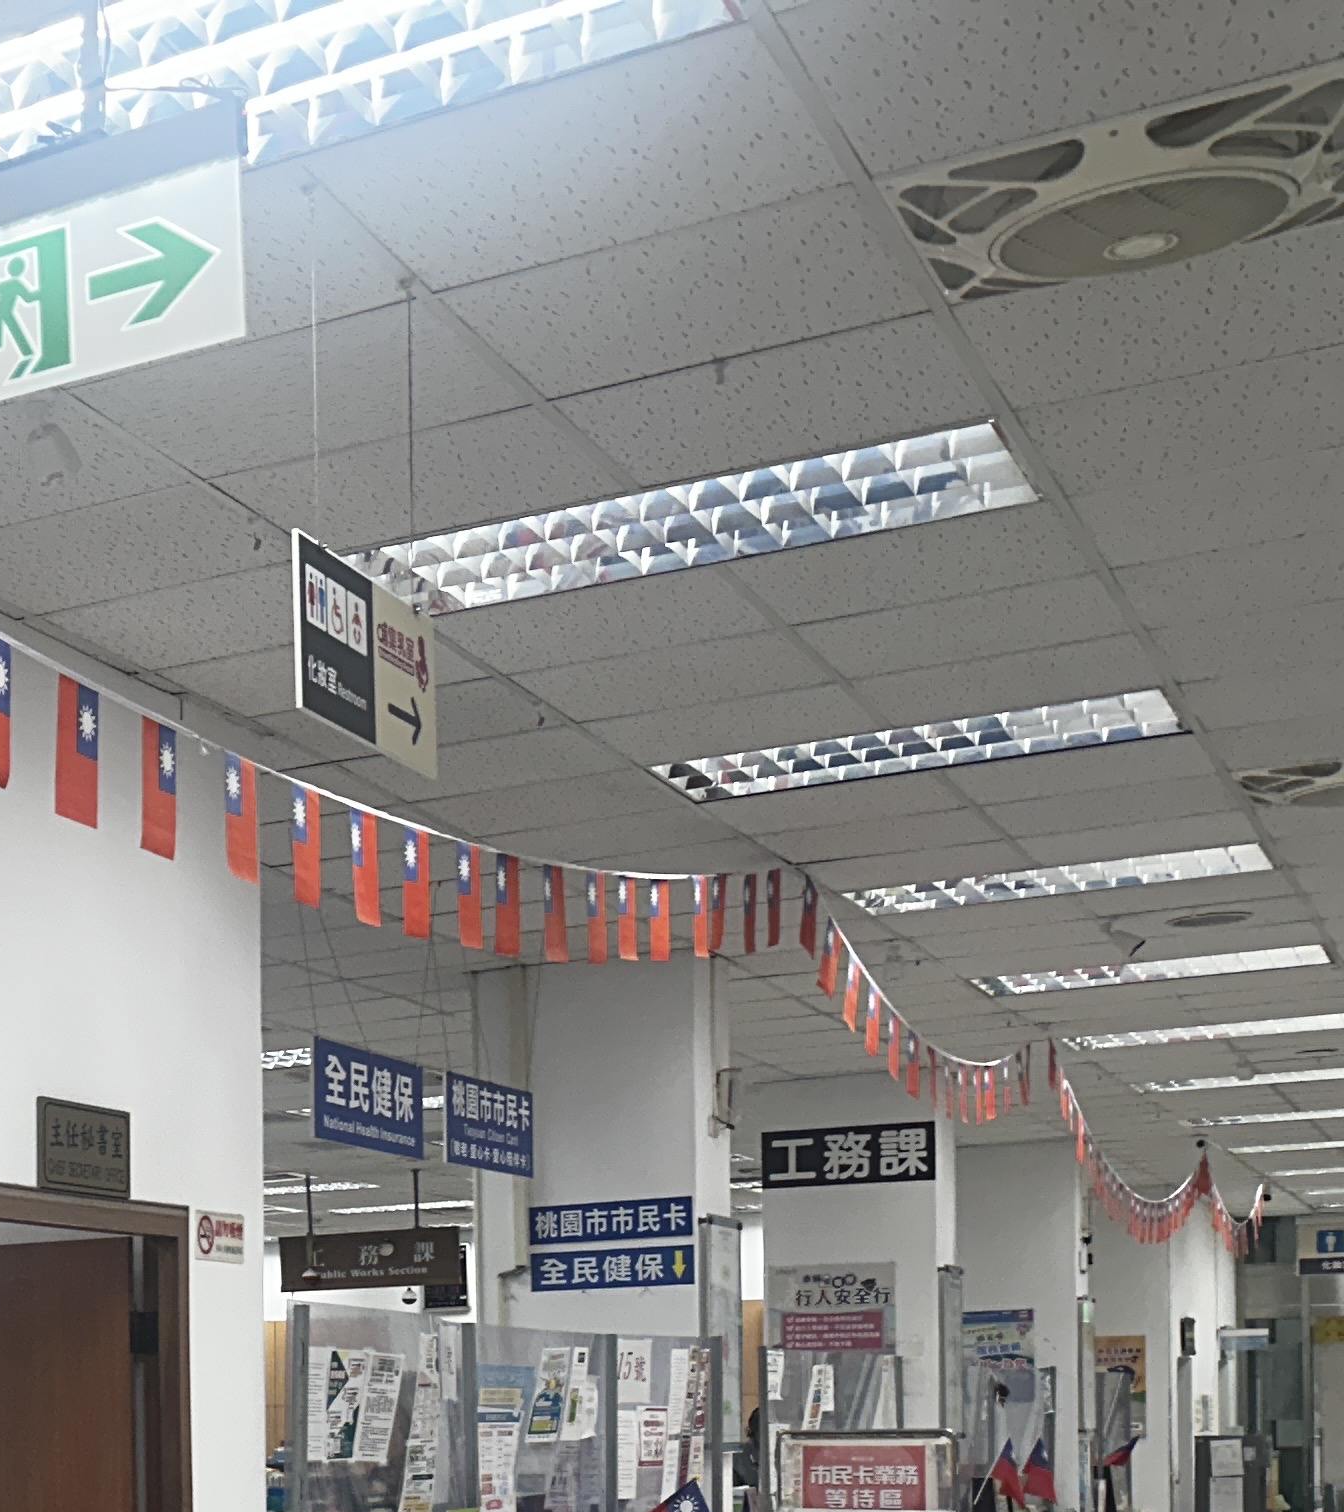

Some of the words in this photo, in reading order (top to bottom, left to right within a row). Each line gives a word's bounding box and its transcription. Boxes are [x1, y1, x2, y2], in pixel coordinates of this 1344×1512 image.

[324, 1054, 414, 1123] 全民健保
[452, 1079, 530, 1132] 桃園市市民卡
[323, 1114, 355, 1134] National
[768, 1127, 929, 1181] 工務課
[534, 1203, 687, 1239] 桃園市市民卡
[313, 1267, 347, 1280] ublic
[350, 1266, 385, 1278] Works
[388, 1264, 428, 1276] Section
[540, 1253, 664, 1285] 全民健保
[809, 1464, 920, 1487] 市民卡業務
[824, 1489, 903, 1509] 等待區
